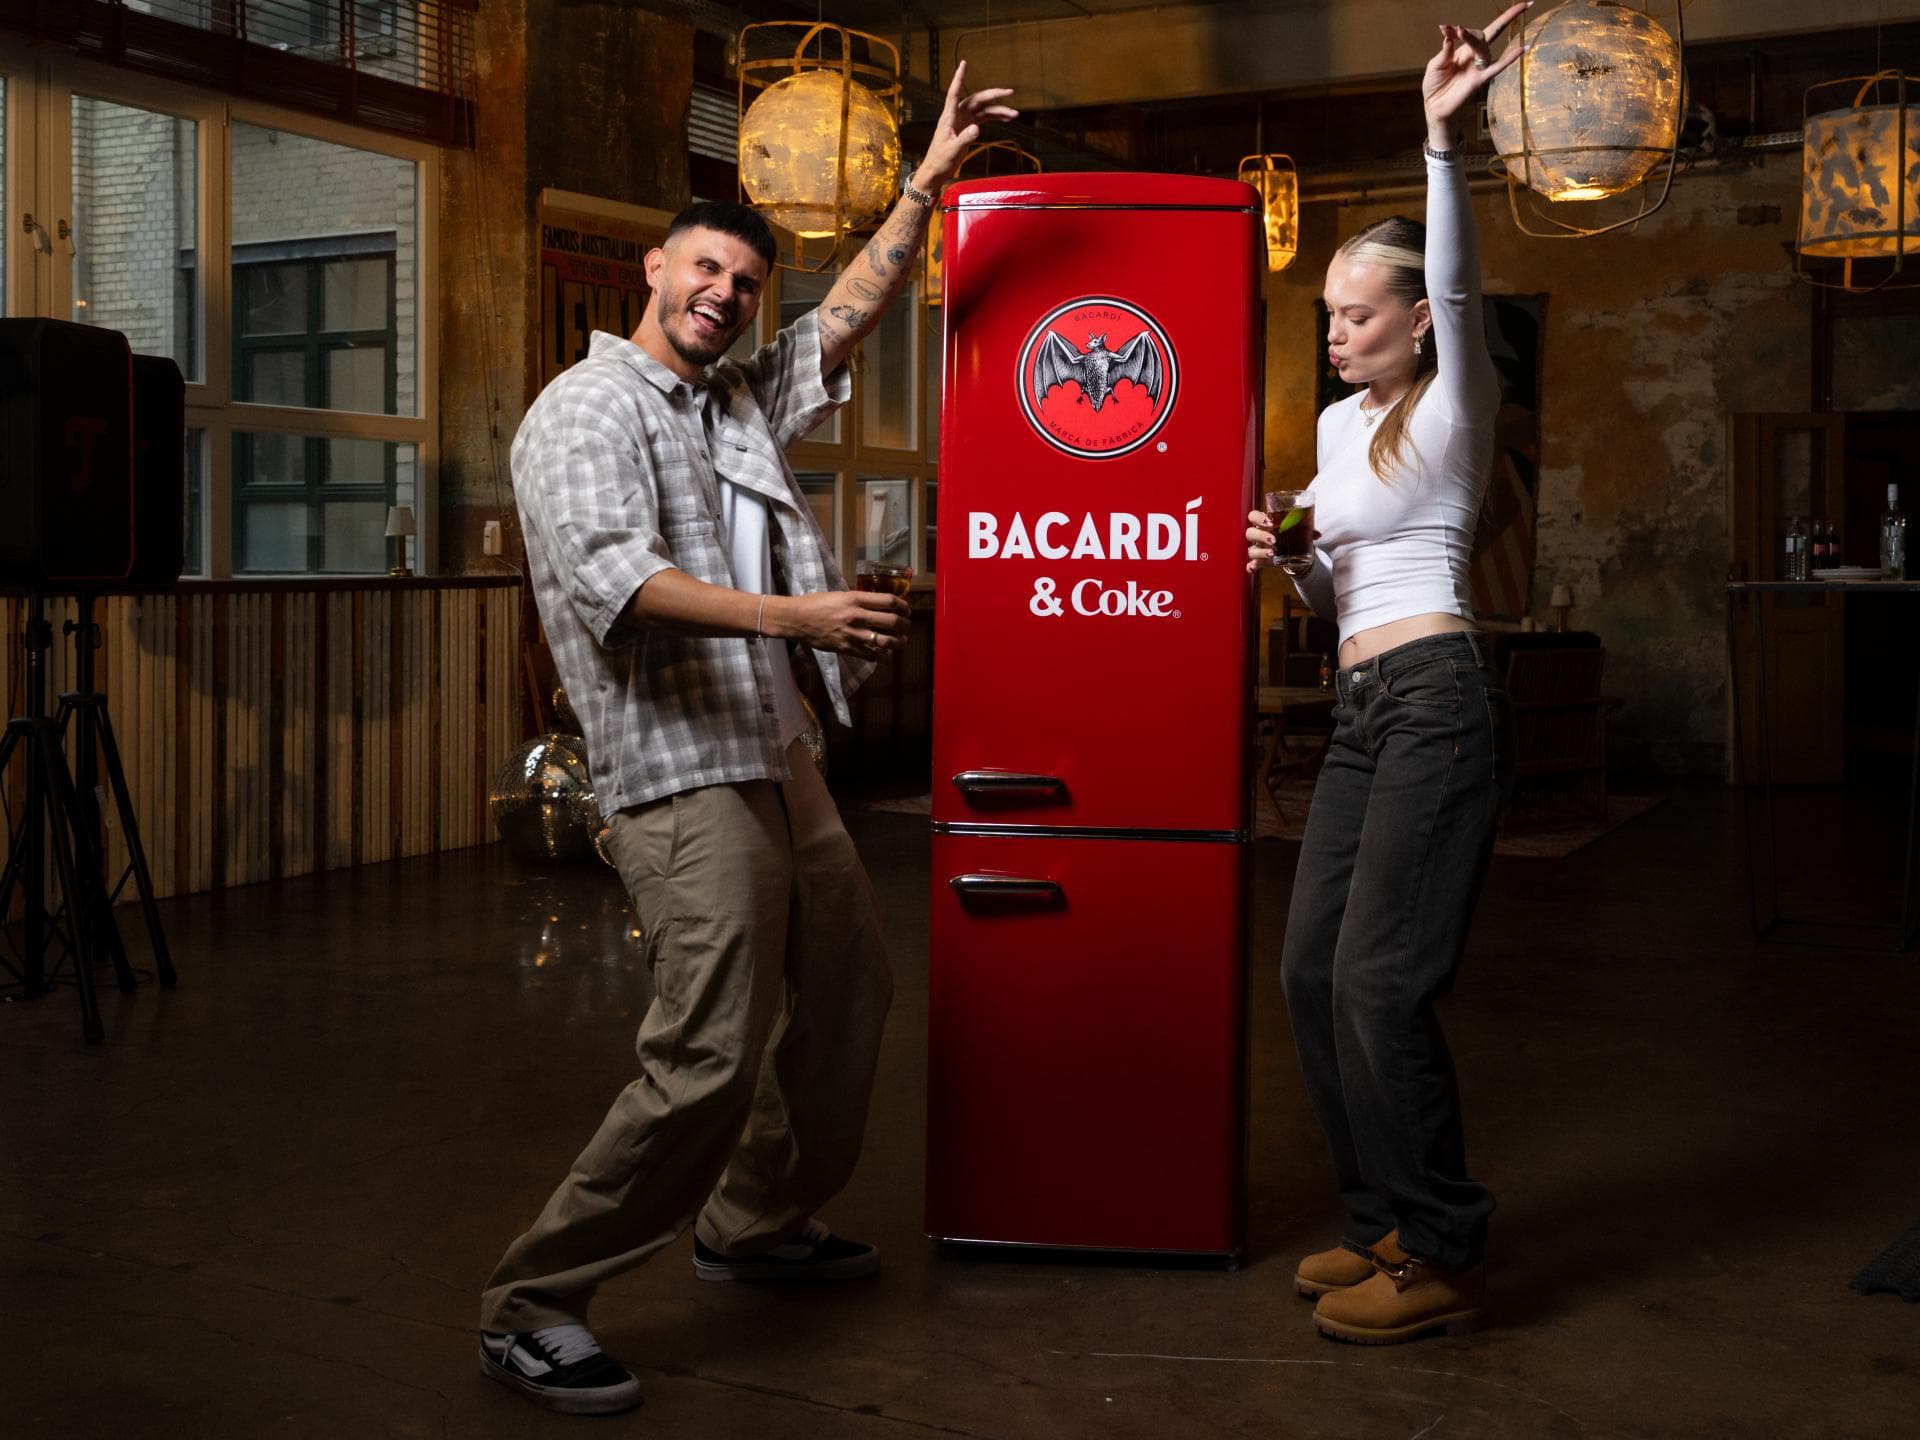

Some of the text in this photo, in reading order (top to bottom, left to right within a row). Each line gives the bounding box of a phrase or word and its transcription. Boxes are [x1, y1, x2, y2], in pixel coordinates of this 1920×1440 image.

[542, 223, 580, 253] FAMOUS
[581, 232, 636, 263] AUSTRALIAN
[1049, 420, 1082, 444] MARCA
[1085, 438, 1098, 447] DE
[1029, 577, 1174, 617] & Coke
